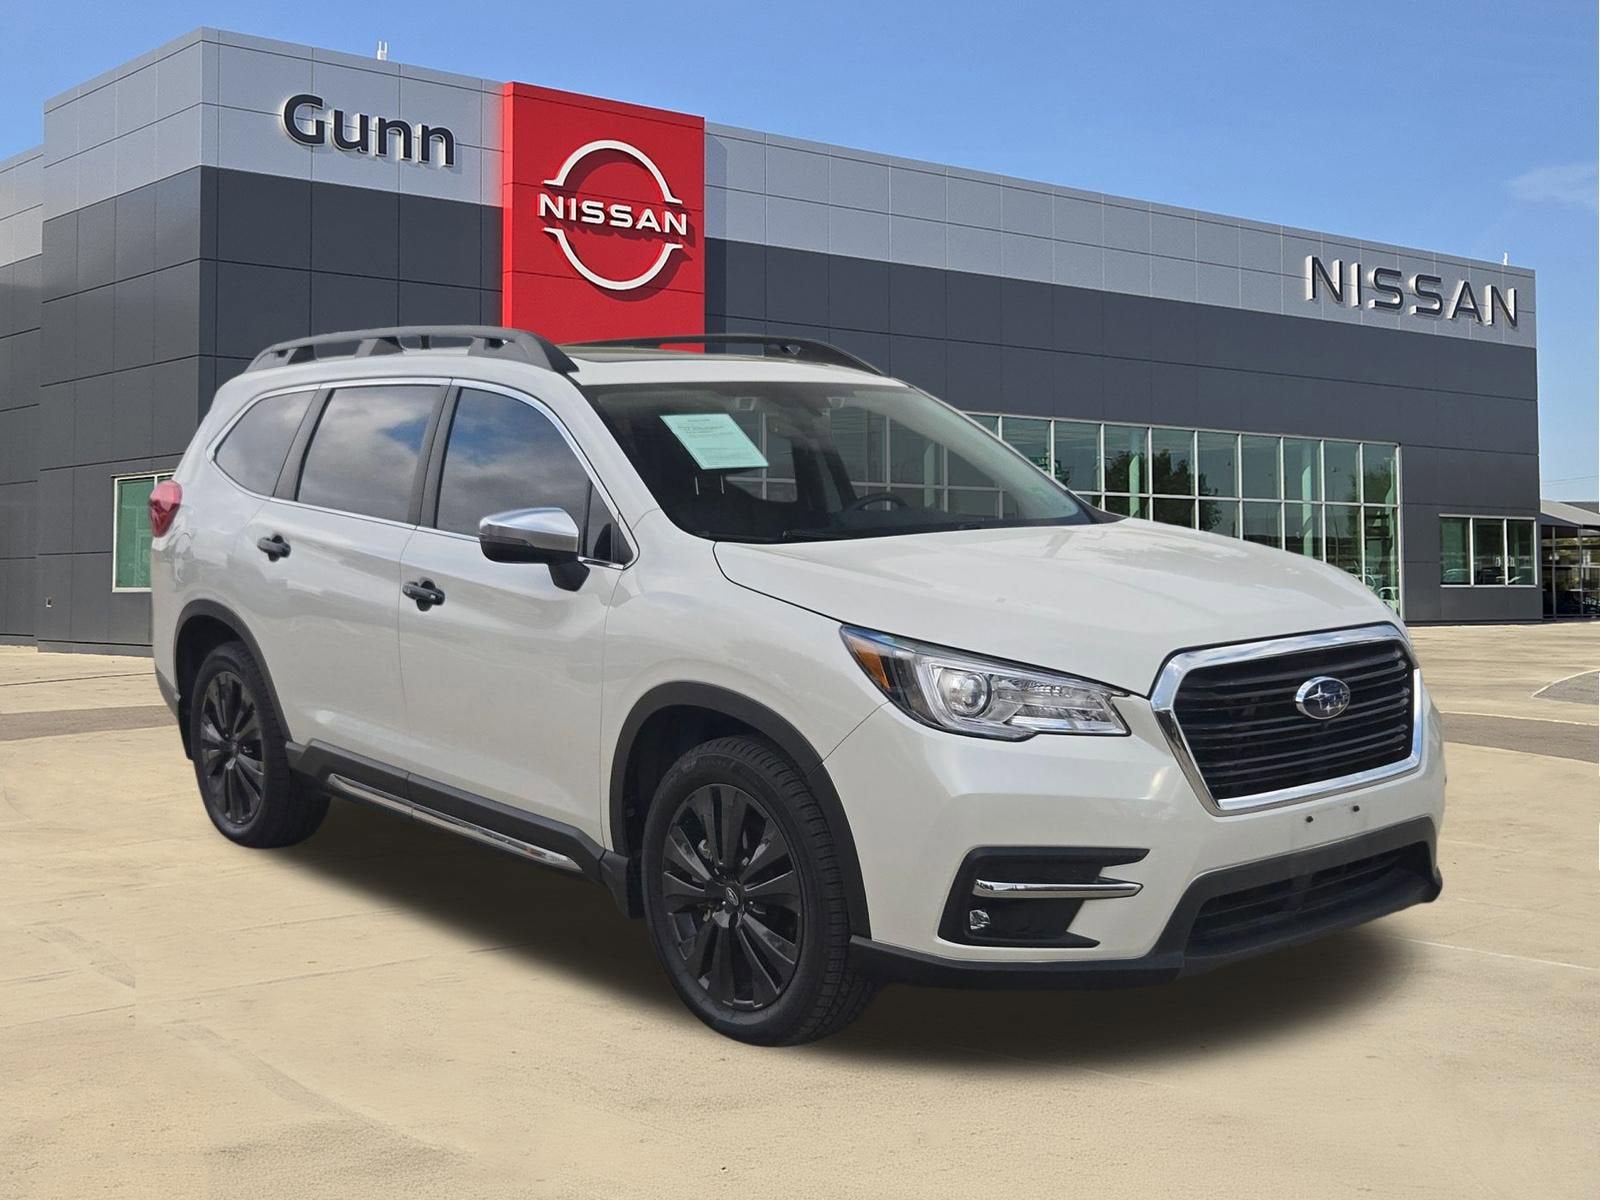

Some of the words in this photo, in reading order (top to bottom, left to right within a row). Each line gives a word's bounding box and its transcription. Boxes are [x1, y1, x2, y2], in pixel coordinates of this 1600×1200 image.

[282, 94, 455, 167] Gunn
[538, 192, 688, 236] NISSAN
[1305, 255, 1518, 327] NISSAN
